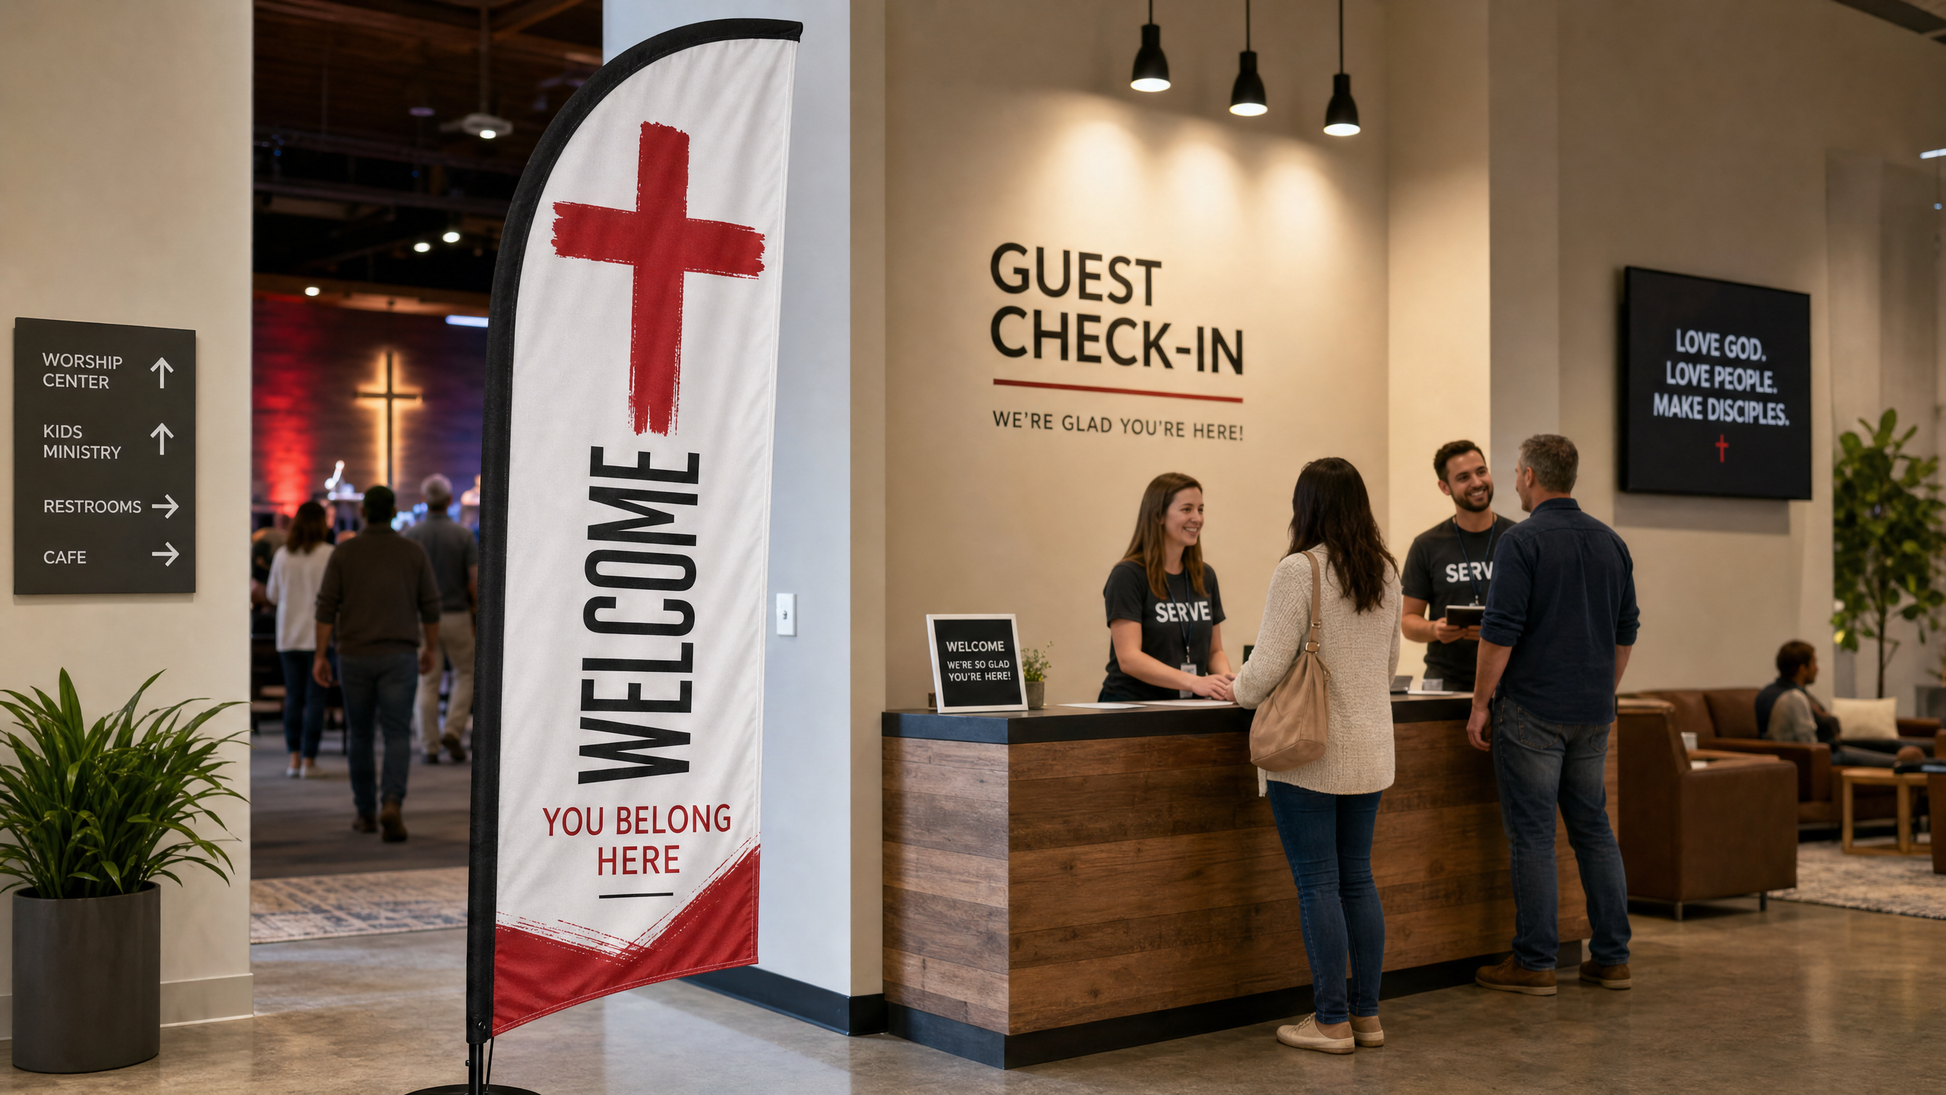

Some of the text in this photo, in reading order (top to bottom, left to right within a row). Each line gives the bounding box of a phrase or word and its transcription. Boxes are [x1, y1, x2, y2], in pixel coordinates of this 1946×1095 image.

[989, 242, 1162, 307] GUEST
[990, 305, 1243, 376] CHECK-IN
[1676, 328, 1767, 362] LOVE GOD.
[42, 352, 123, 370] WORSHIP
[42, 373, 110, 391] CENTER
[1666, 360, 1778, 394] LOVE PEOPLE.
[1653, 392, 1790, 427] MAKE DISCIPLES.
[43, 424, 83, 439] KIDS
[992, 410, 1243, 441] WE'RE GLAD YOU'RE HERE!
[43, 444, 122, 460] MINISTRY
[44, 499, 142, 514] RESTROOMS
[43, 550, 87, 565] CAFE
[1445, 561, 1494, 583] SERV
[577, 445, 700, 785] WELCOME
[1154, 600, 1212, 623] SERVE
[945, 640, 1005, 652] WELCOME
[946, 659, 1010, 670] WE'RE SO GLAD
[948, 671, 1011, 682] YOU'RE HERE!
[542, 803, 731, 837] YOU BELONG
[598, 844, 680, 876] HERE
